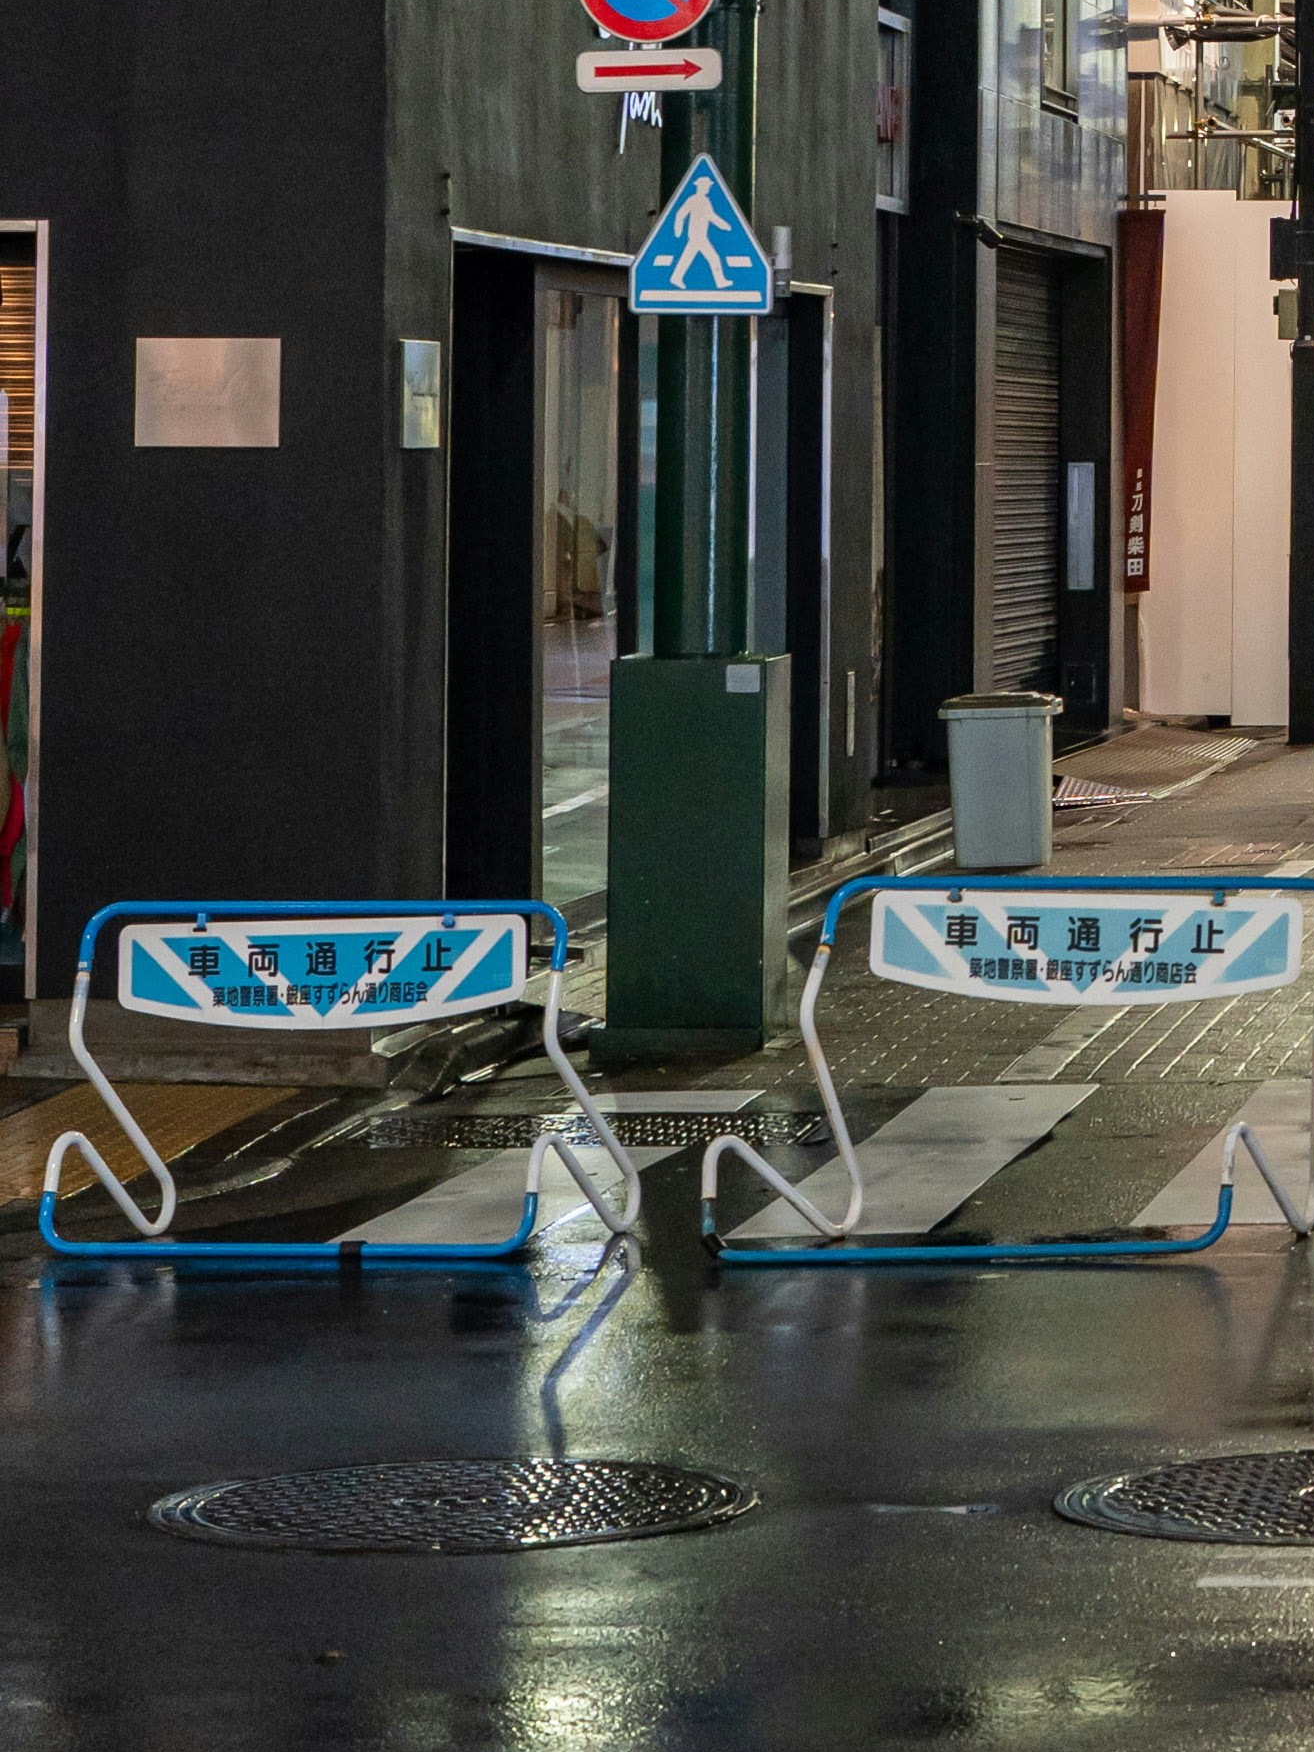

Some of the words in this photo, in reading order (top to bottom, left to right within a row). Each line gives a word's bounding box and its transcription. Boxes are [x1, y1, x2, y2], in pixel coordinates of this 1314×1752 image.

[1128, 493, 1144, 577] 刀剣柴田
[945, 914, 1225, 954] 車両通行止
[188, 935, 454, 979] 車両通行止
